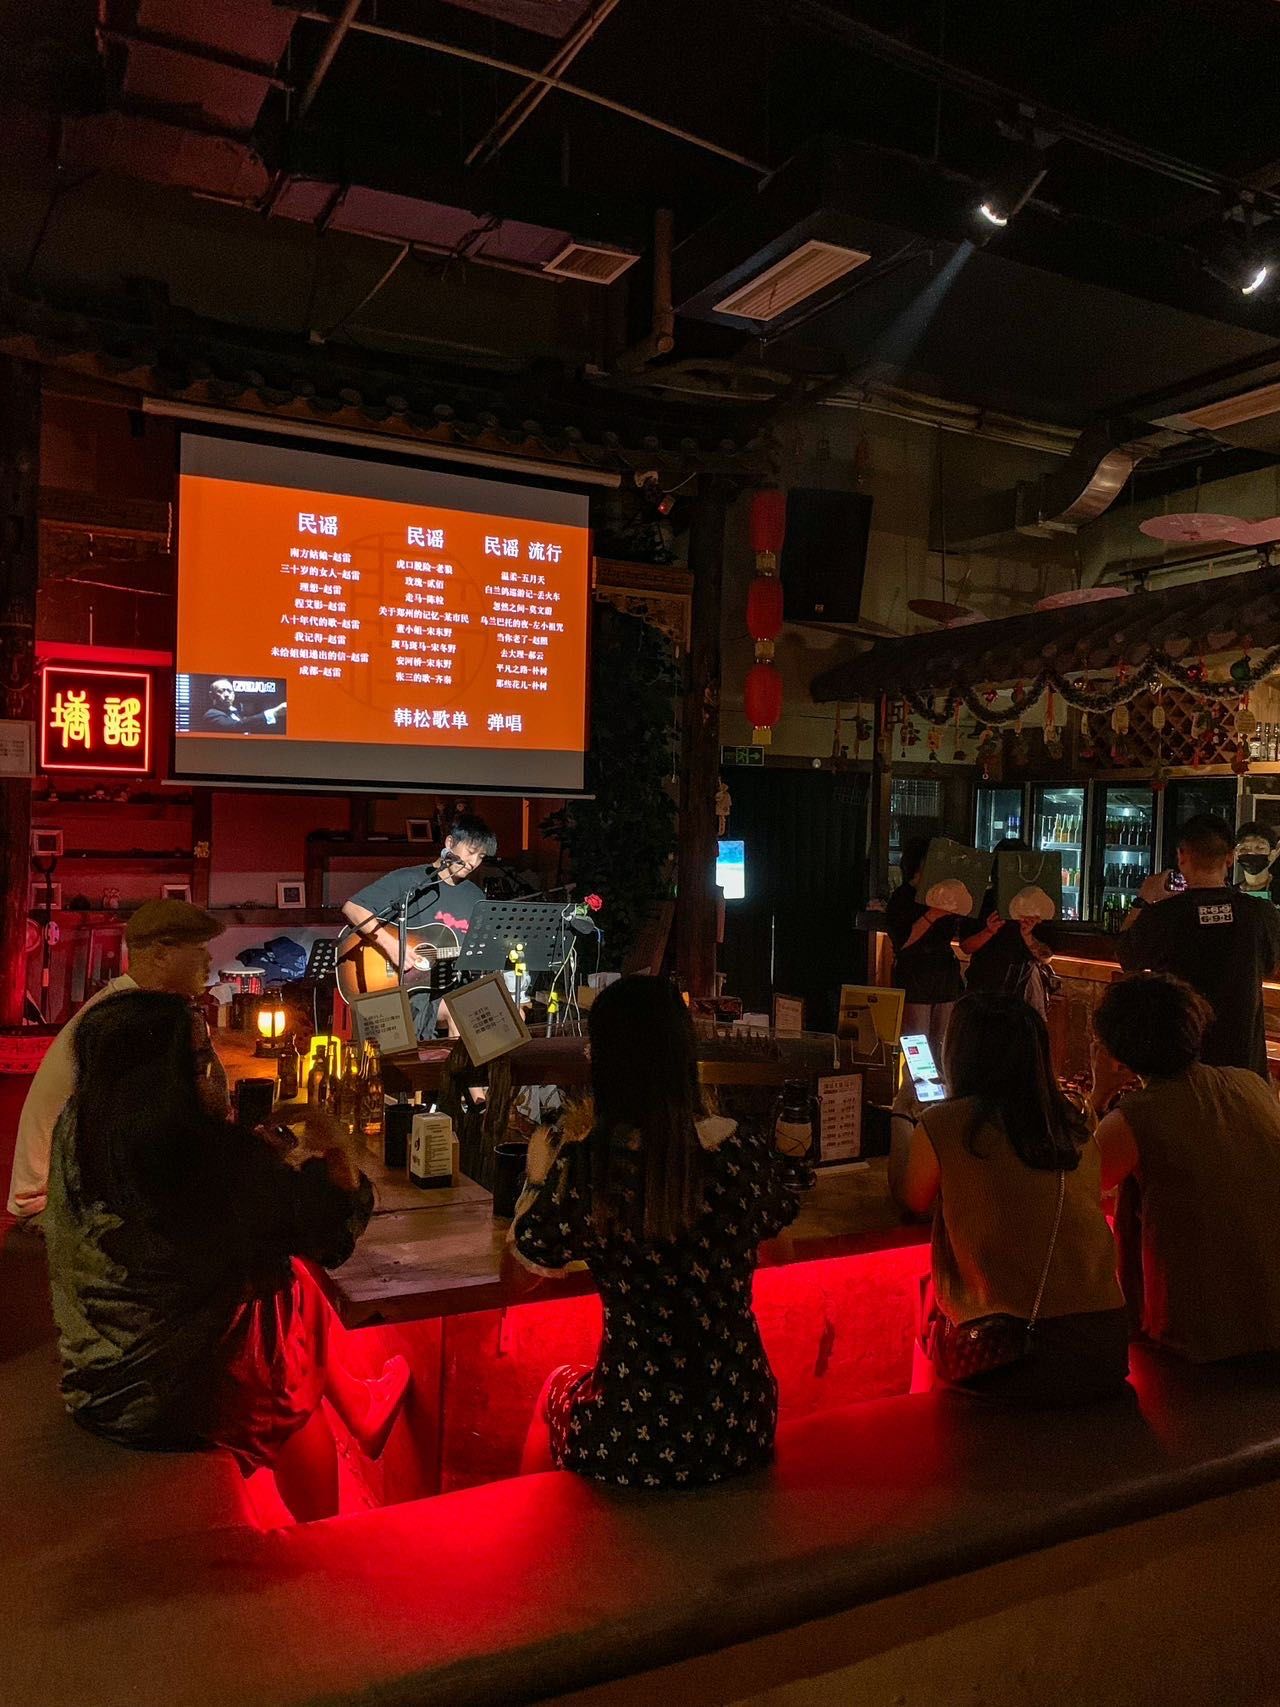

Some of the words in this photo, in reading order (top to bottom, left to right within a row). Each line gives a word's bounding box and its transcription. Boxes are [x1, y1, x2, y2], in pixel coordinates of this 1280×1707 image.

[298, 512, 339, 537] 民谣
[407, 525, 445, 550] 民谣
[484, 535, 520, 558] 民谣
[528, 541, 563, 563] 流行
[393, 707, 469, 730] 韩松歌单
[487, 713, 523, 733] 弹唱
